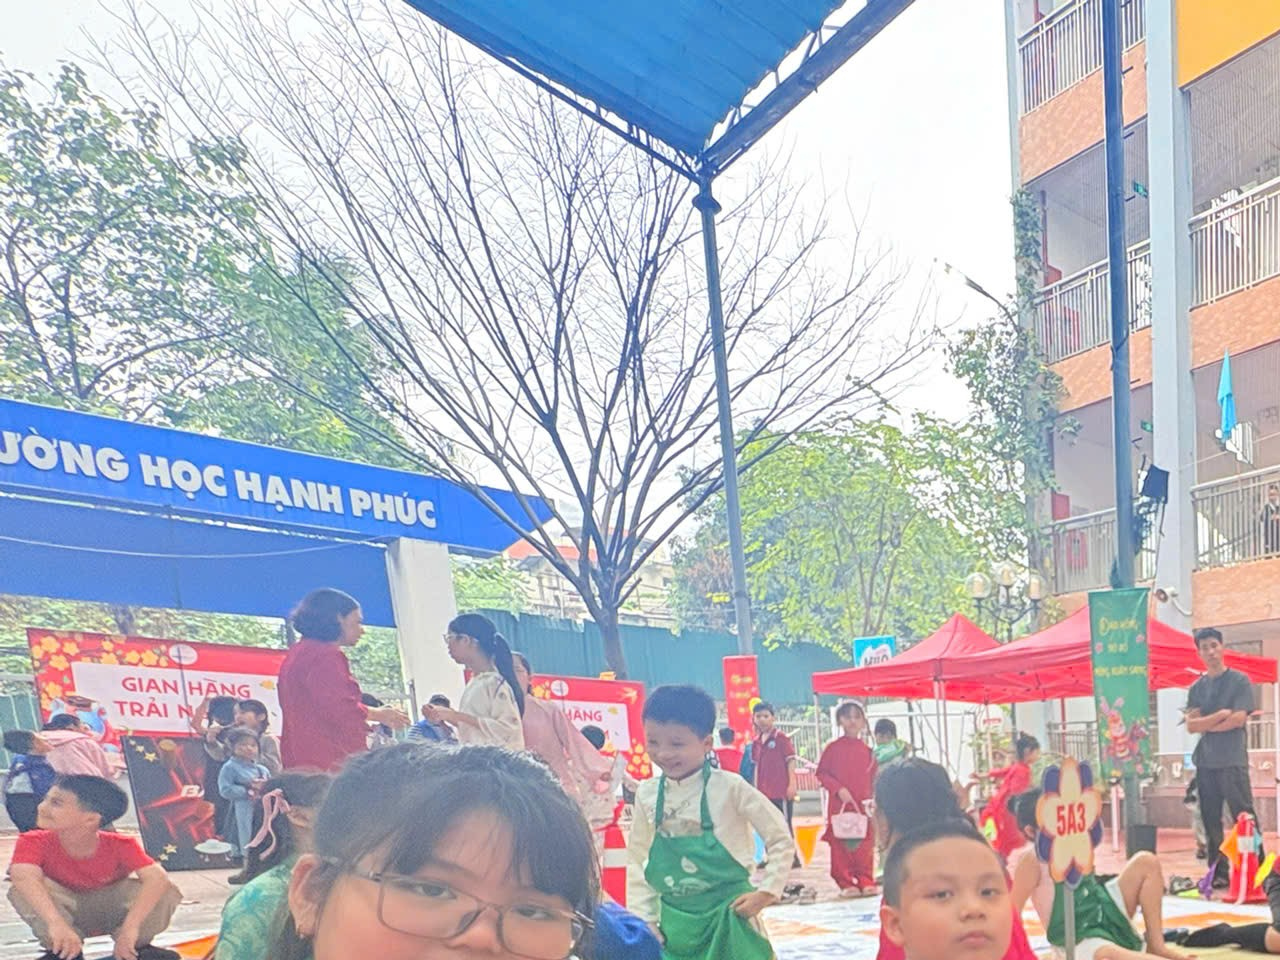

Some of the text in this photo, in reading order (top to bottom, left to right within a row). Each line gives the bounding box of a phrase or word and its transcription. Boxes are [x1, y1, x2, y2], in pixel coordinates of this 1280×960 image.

[139, 453, 228, 500] HỌC
[234, 469, 345, 514] HẠNH
[350, 491, 437, 528] PHÚC
[122, 676, 251, 698] GIAN HÀNG
[114, 697, 168, 718] TRẢI
[1056, 801, 1086, 837] 5A3
